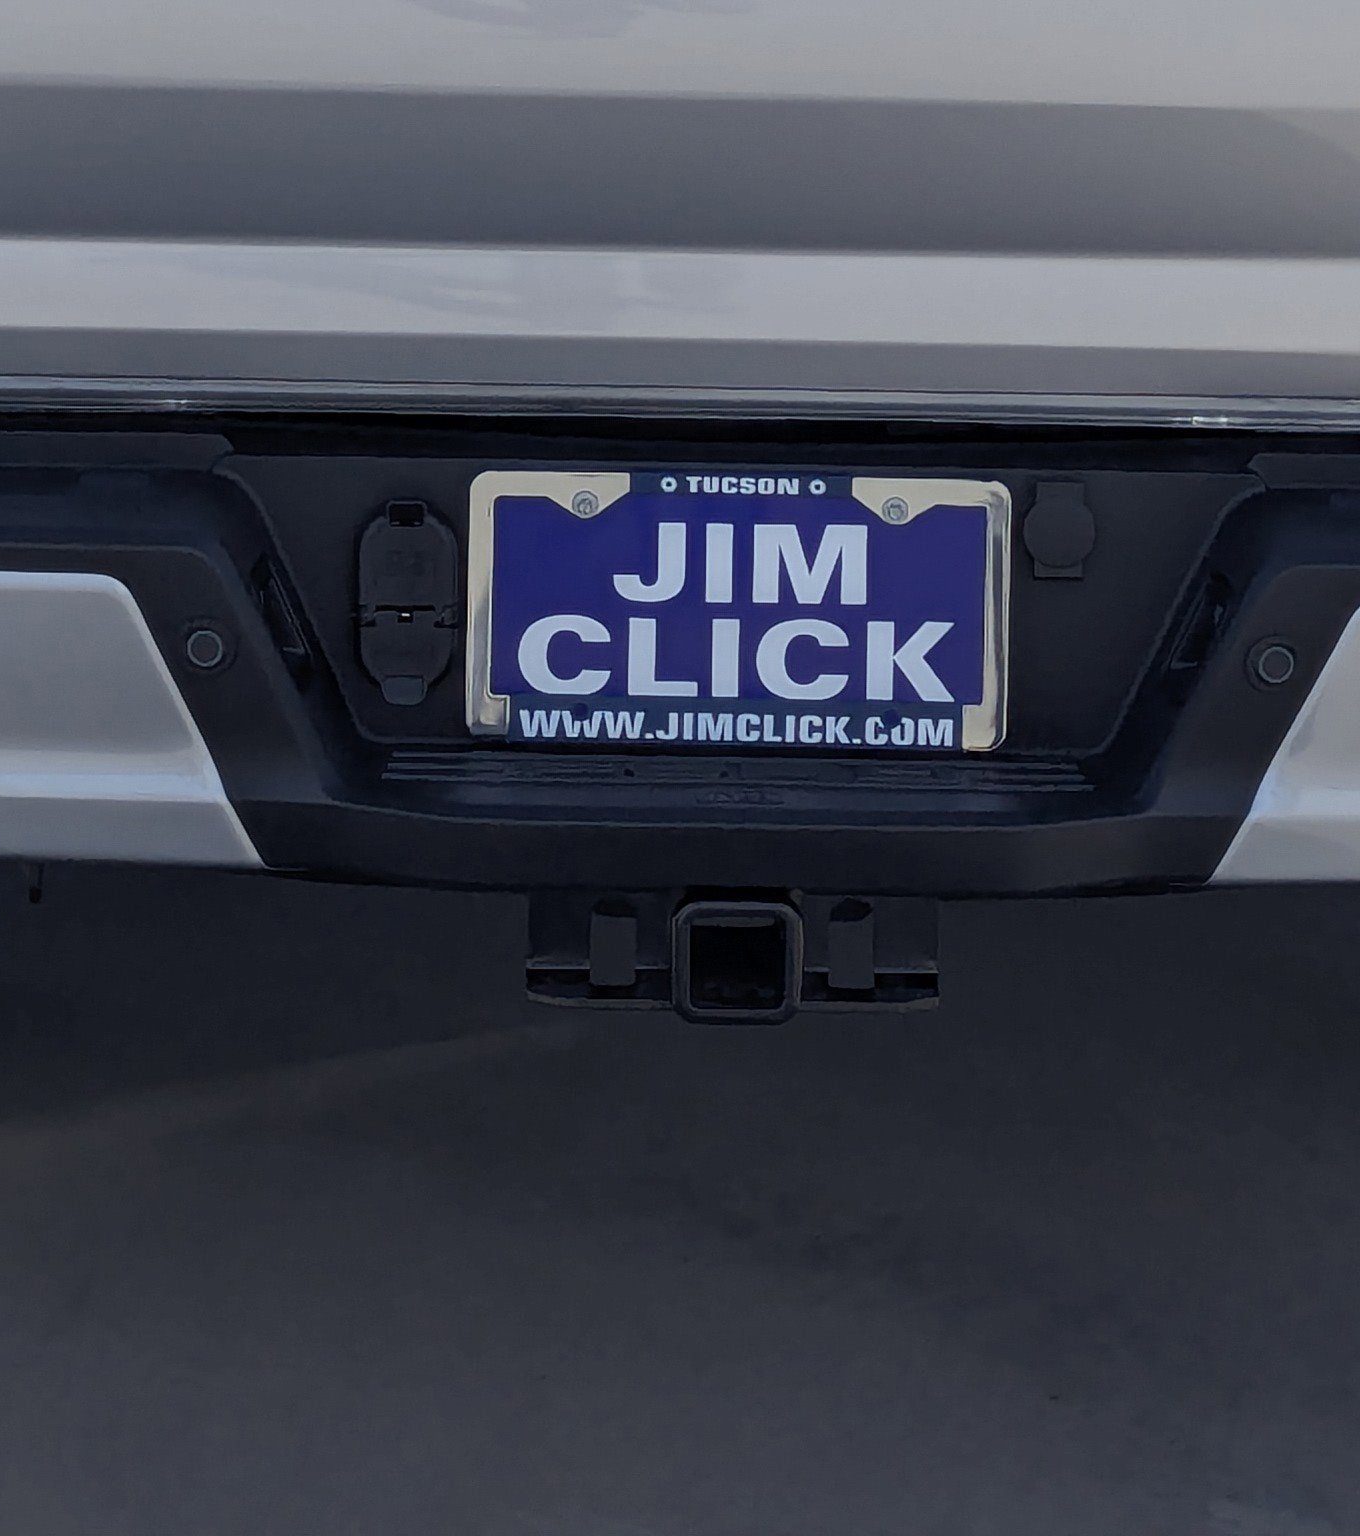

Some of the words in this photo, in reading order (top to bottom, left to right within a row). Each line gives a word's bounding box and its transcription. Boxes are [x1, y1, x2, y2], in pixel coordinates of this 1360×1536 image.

[686, 475, 800, 496] TUCSON
[612, 522, 869, 605] JIM
[517, 614, 955, 703] CLICK
[519, 709, 954, 747] WWW.JIMCLICK.COM
